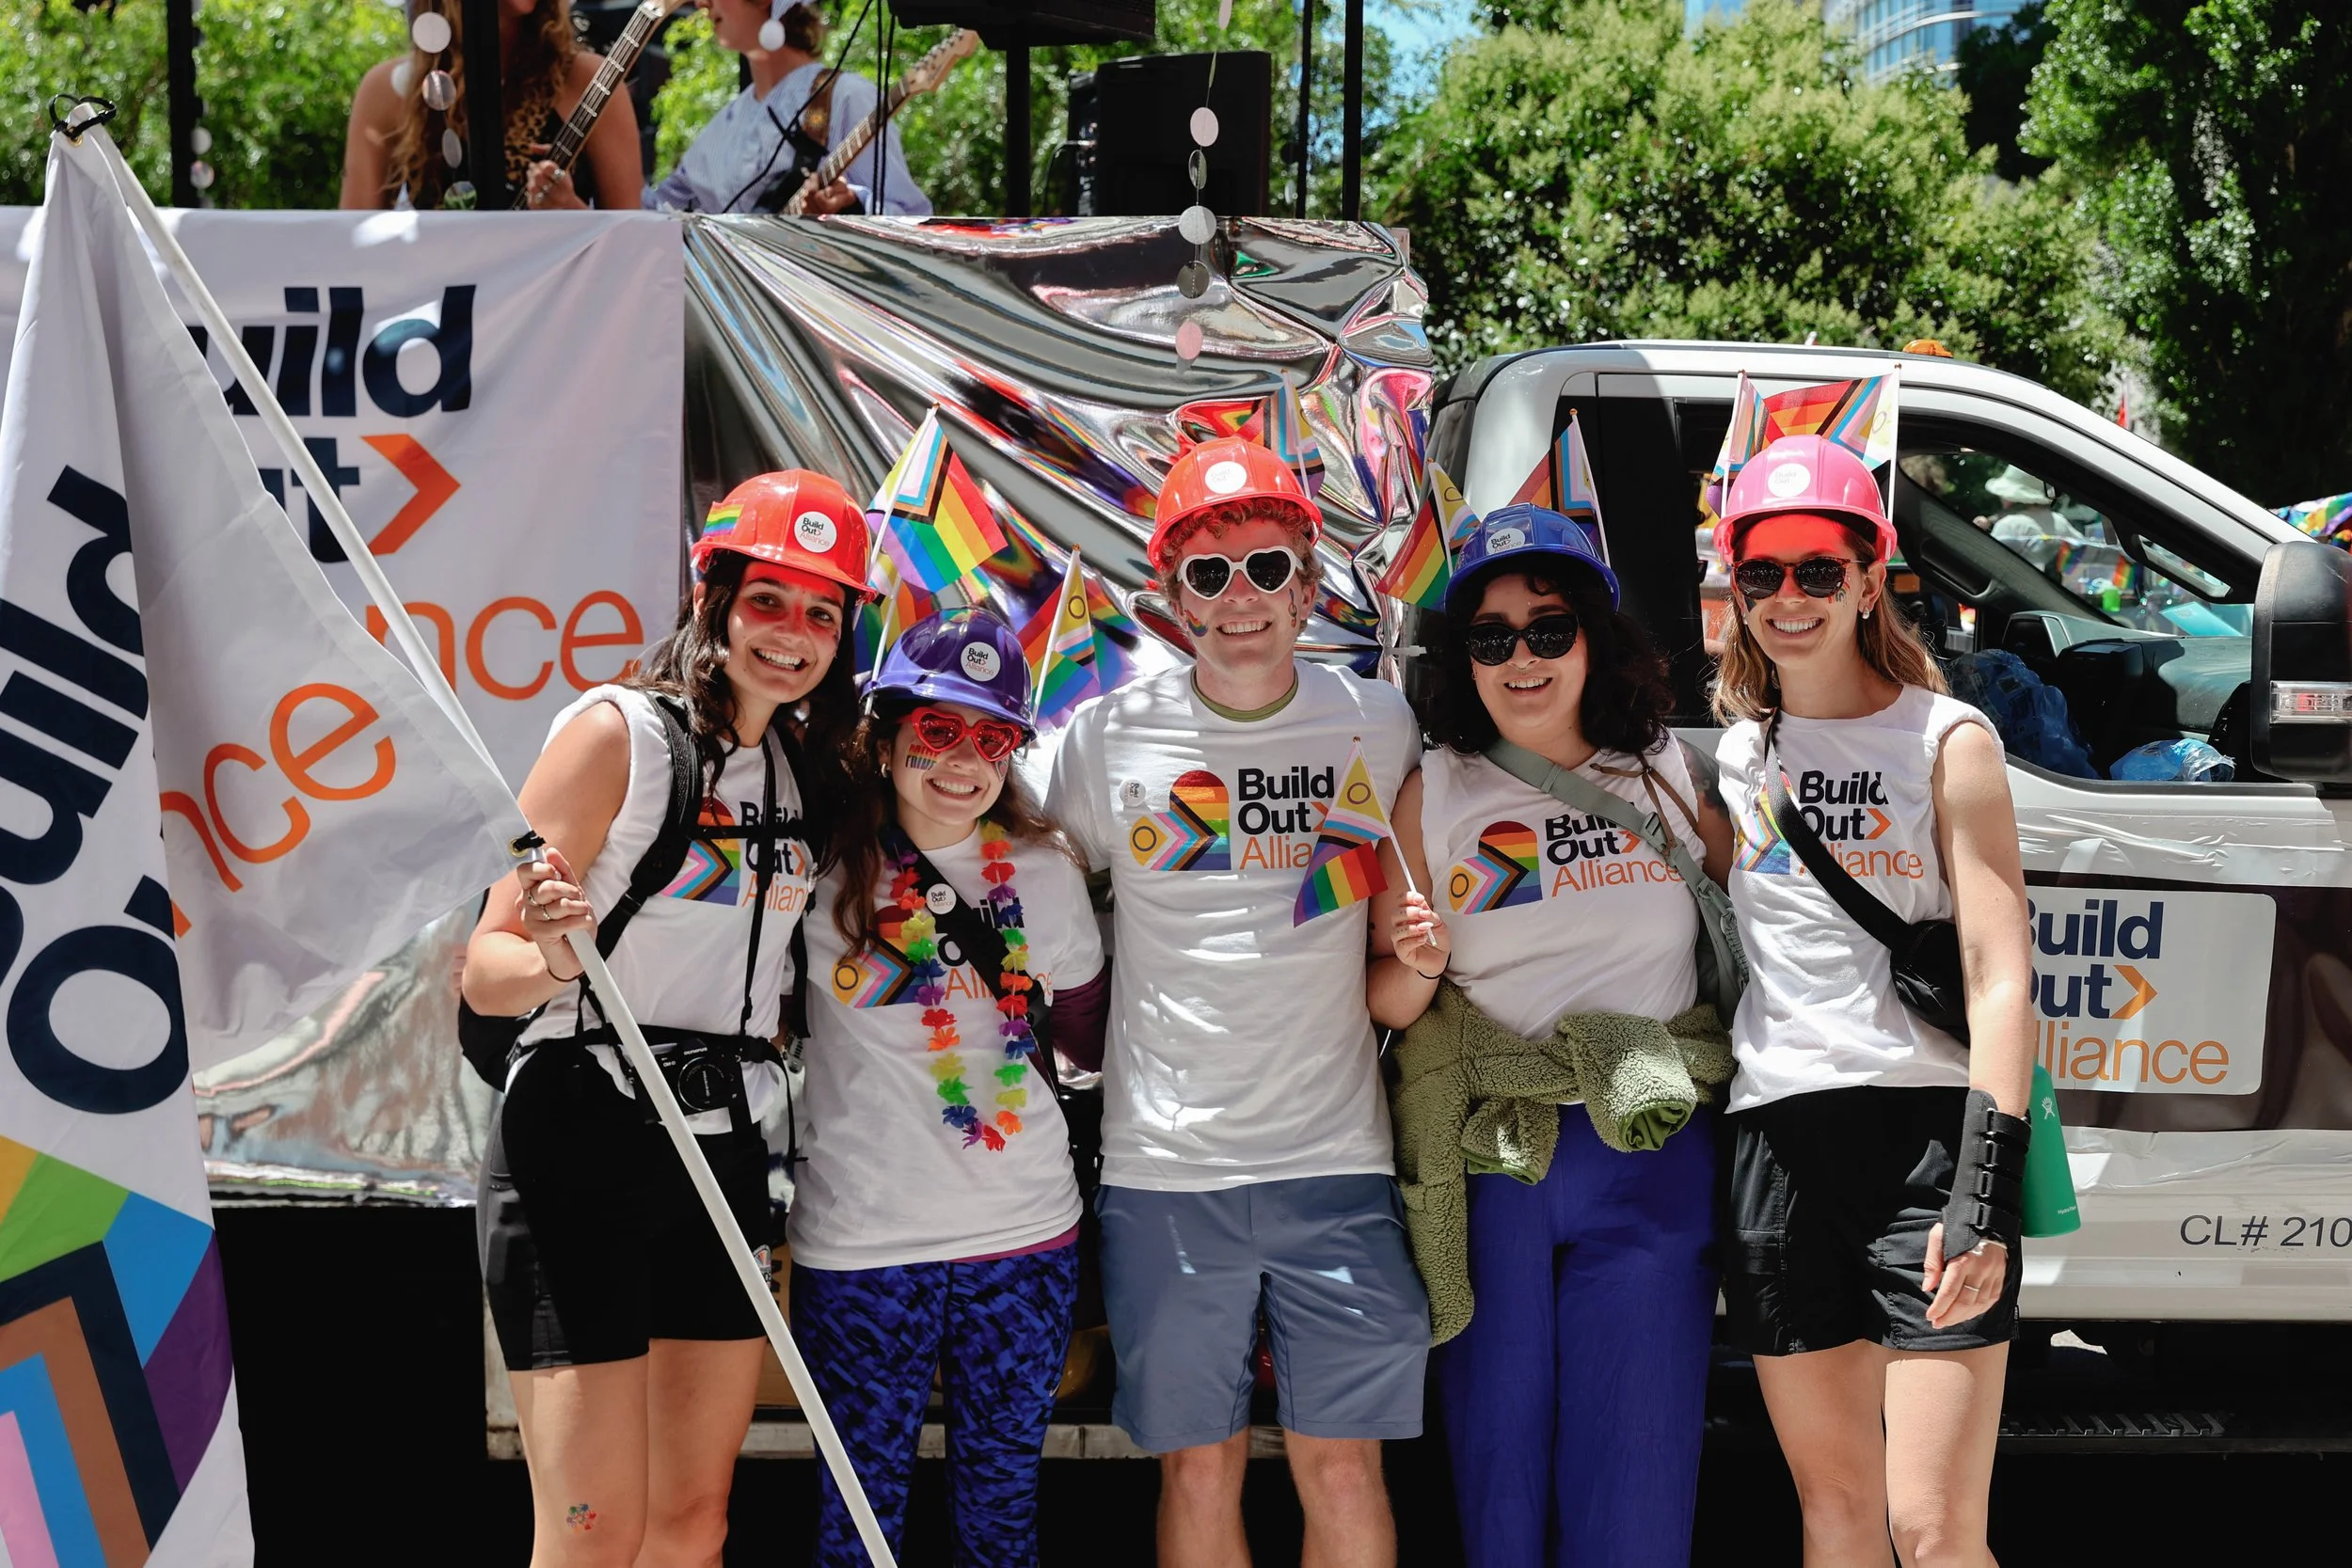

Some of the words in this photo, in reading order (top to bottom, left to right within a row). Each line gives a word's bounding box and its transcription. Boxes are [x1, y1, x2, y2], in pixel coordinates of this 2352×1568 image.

[801, 524, 818, 535] Out
[803, 517, 824, 531] Build
[1491, 533, 1511, 545] Build
[1492, 540, 1507, 549] Out
[966, 654, 981, 665] Out
[968, 647, 989, 660] Build
[1238, 766, 1334, 801] Build
[1237, 801, 1311, 835] Out
[1239, 835, 1312, 870] Allia
[1547, 831, 1620, 865] Out
[2026, 898, 2164, 959] uild
[2031, 964, 2113, 1019] ut
[2180, 1214, 2268, 1246] CL#
